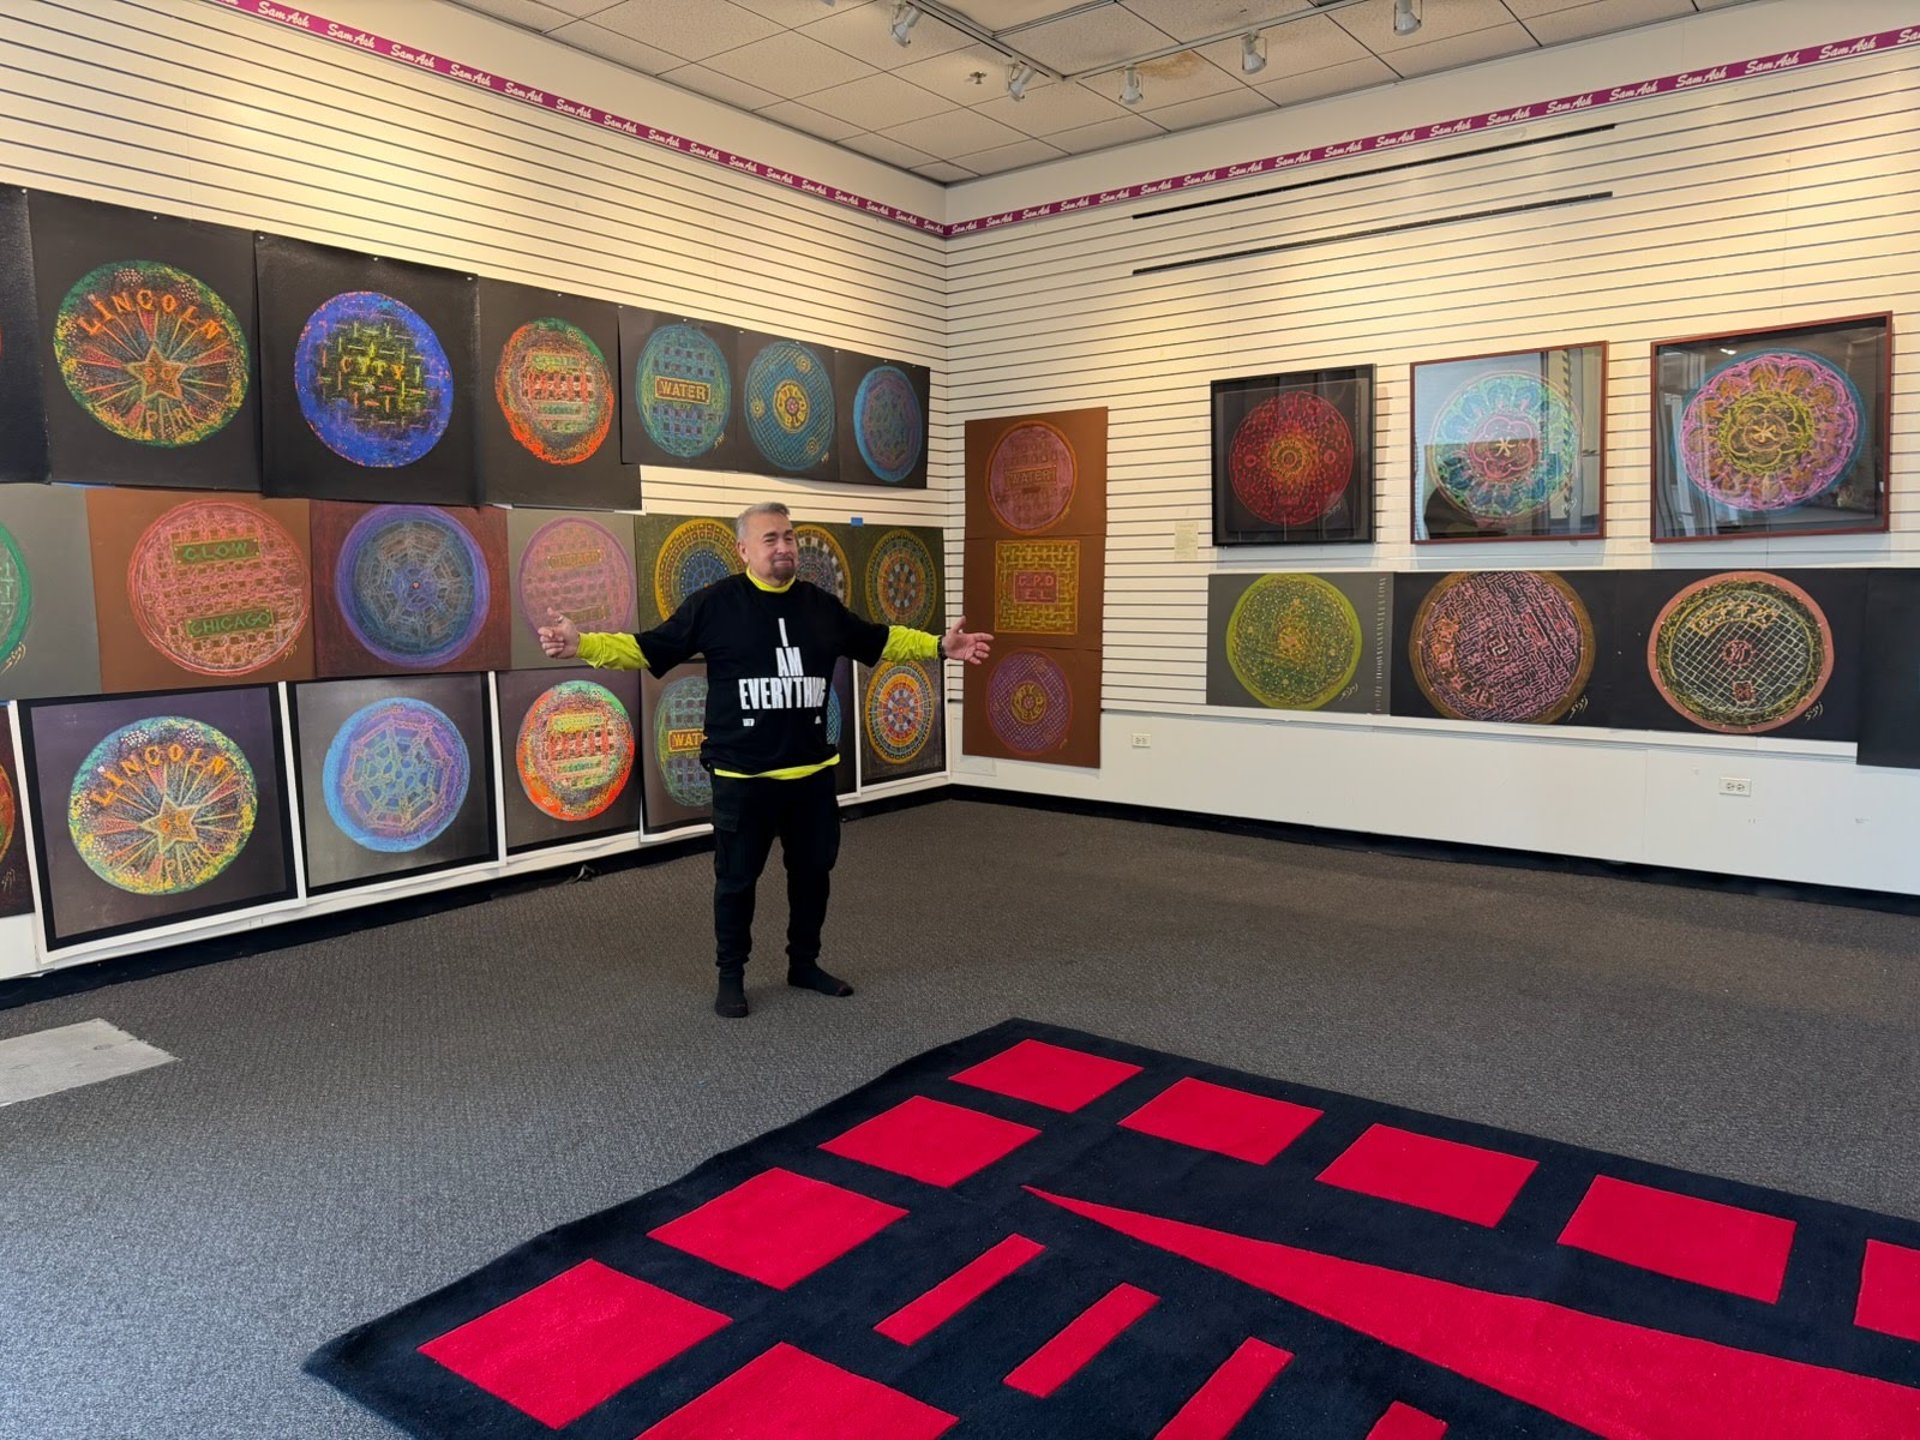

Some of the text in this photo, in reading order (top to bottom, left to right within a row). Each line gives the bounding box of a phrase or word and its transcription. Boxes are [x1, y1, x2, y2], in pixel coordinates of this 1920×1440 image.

[256, 0, 286, 19] Sam
[285, 12, 309, 27] Ash
[327, 23, 374, 48] Sam Ash
[1897, 28, 1919, 43] Sa
[390, 44, 434, 67] Sam Ash
[1818, 36, 1876, 59] Sam Ash
[1744, 52, 1799, 73] Sam Ash
[449, 63, 490, 85] Sam Ash
[1675, 66, 1726, 87] Sam Ash
[504, 82, 542, 102] Sam Ash
[1608, 81, 1657, 100] Sam Ash
[555, 98, 591, 118] Sam Ash
[1545, 94, 1592, 113] Sam Ash
[603, 114, 636, 133] Sam Ash
[1486, 107, 1530, 125] Sam Ash
[1429, 119, 1471, 136] Sam Ash
[647, 129, 679, 147] Sam Ash
[1375, 130, 1415, 147] Sam Ash
[689, 142, 718, 159] Sam Ash
[1324, 141, 1362, 157] Sam Ash
[728, 155, 756, 172] Sam Ash
[1274, 151, 1311, 167] Sam Ash
[766, 167, 792, 183] Sam Ash
[1227, 161, 1262, 176] Sam Ash
[801, 179, 826, 195] Sam Ash
[1139, 180, 1171, 194] Sam Ash
[1182, 171, 1216, 186] Sam Ash
[834, 190, 858, 205] Sam Ash
[1059, 197, 1088, 211] Sam Ash
[1098, 189, 1129, 203] Sam Ash
[866, 200, 888, 215] Sam Ash
[1021, 205, 1049, 219] Sam Ash
[895, 210, 916, 224] Sam Ash
[985, 213, 1012, 226] Sam Ash
[923, 220, 943, 233] Sam Ash
[951, 221, 976, 233] Sam Ash
[77, 289, 222, 337] LINCOLN
[660, 381, 705, 400] WATER
[190, 612, 269, 634] CHICAGO
[778, 618, 788, 647] I
[775, 647, 803, 677] AM
[90, 743, 229, 806] LINCOLN
